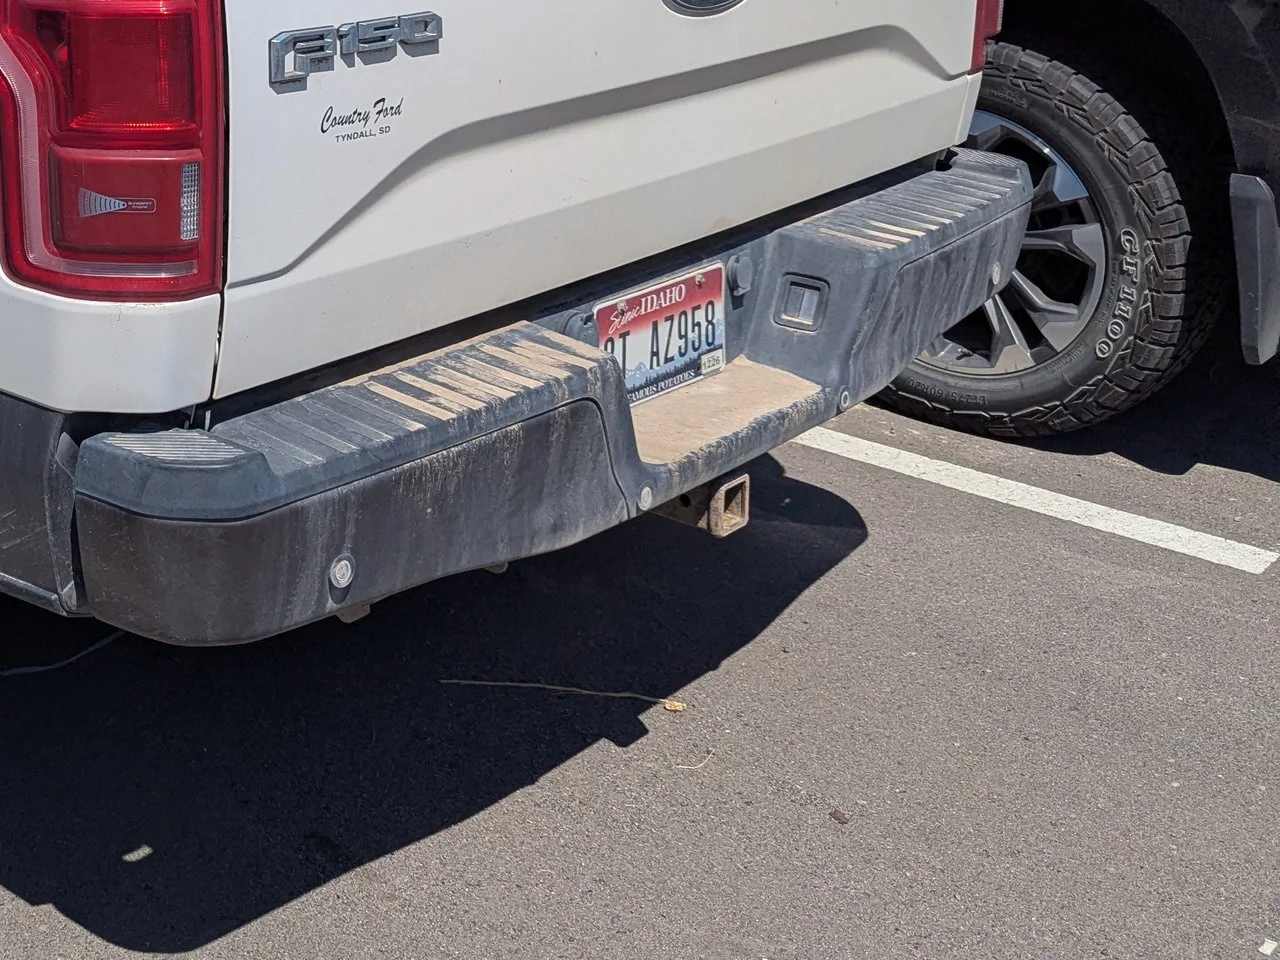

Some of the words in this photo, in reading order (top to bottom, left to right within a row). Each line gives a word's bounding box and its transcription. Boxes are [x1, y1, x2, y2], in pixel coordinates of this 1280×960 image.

[321, 106, 370, 133] Country
[373, 97, 403, 124] Ford
[335, 129, 376, 143] TYNDALL,
[379, 125, 391, 135] SD
[639, 283, 686, 315] IDAHO
[649, 300, 716, 370] AZ958
[657, 369, 695, 392] POTATOES
